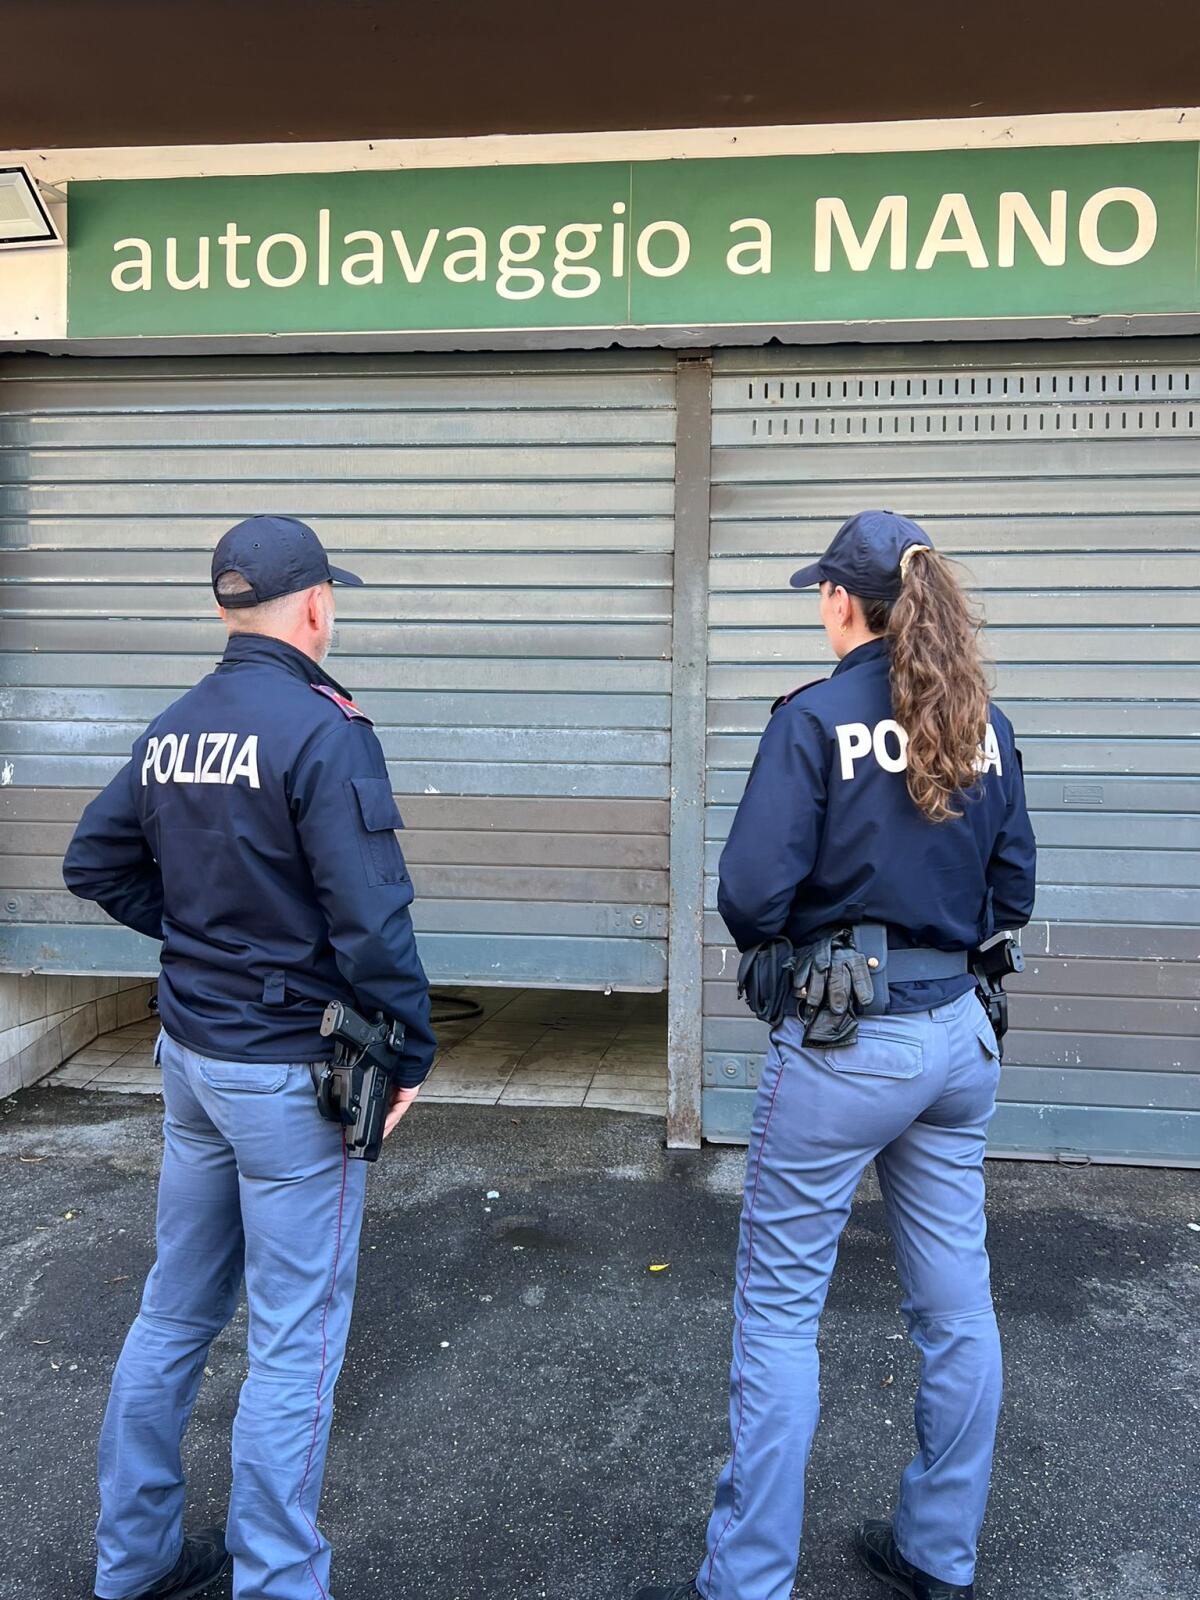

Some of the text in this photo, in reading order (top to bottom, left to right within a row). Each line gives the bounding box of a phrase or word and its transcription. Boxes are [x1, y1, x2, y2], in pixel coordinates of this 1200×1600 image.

[111, 187, 1157, 300] autolavaggio a MANO
[141, 732, 261, 789] POLIZIA
